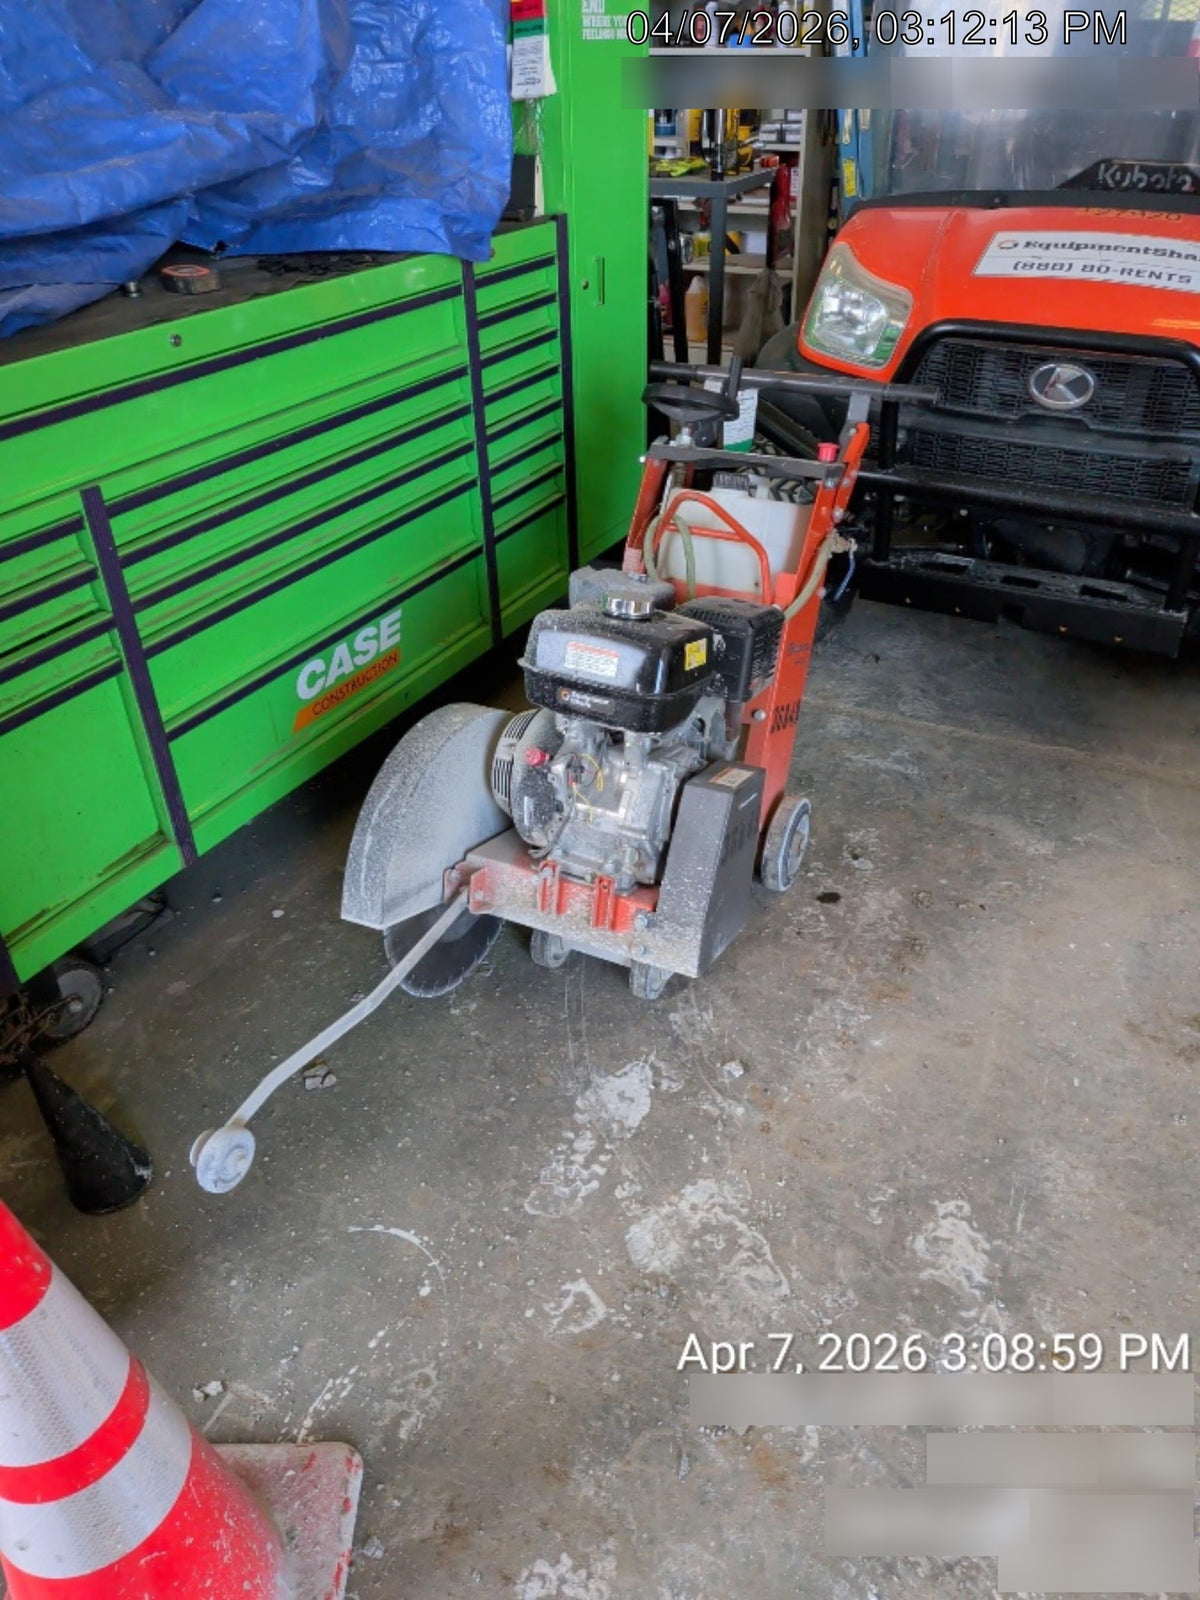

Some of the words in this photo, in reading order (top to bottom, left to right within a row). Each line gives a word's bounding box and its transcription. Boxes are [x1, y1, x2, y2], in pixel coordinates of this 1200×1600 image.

[1098, 163, 1194, 192] Kubota
[1023, 240, 1200, 263] EquipmentSha
[1081, 264, 1192, 284] 80-RENTS
[297, 608, 402, 700] CASE
[312, 652, 399, 716] CONSTRUCTION
